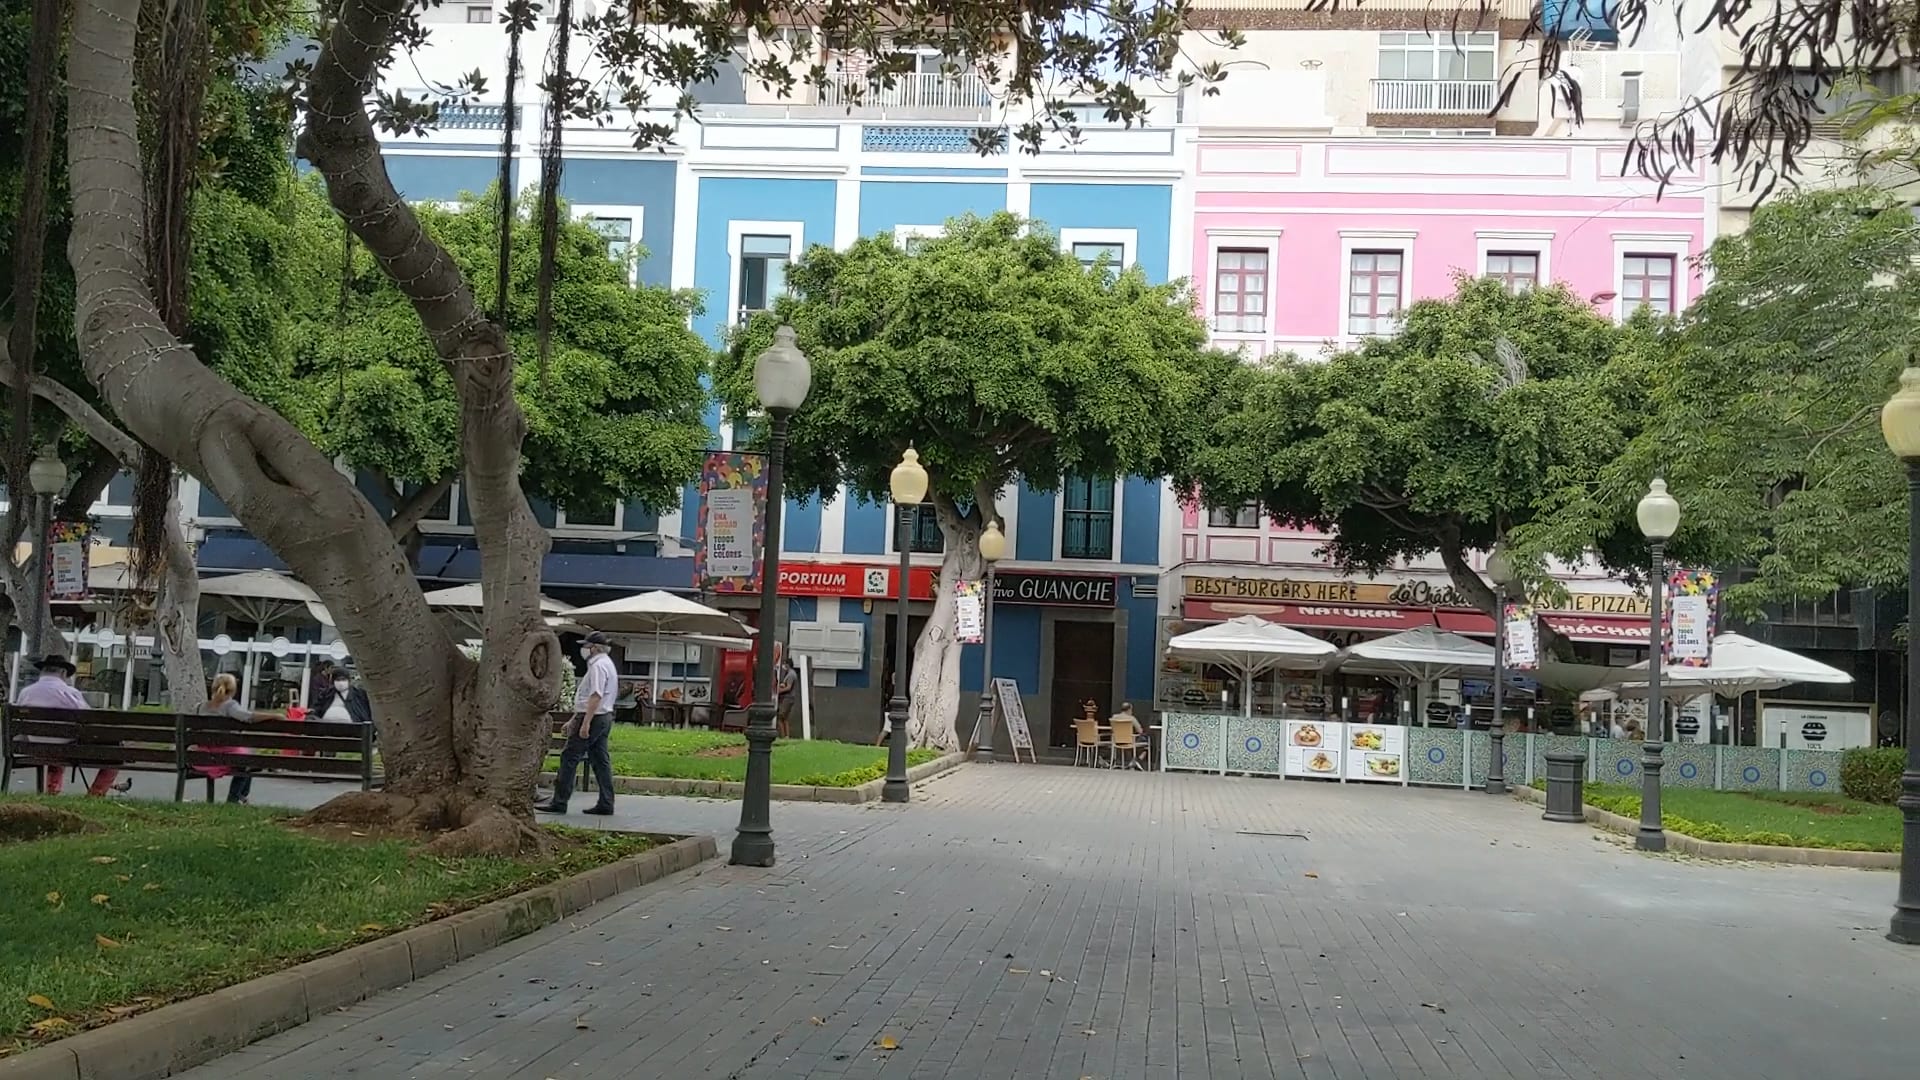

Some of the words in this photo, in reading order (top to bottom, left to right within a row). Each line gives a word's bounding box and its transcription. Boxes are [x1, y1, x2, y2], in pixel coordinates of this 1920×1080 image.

[713, 543, 726, 551] LOS
[713, 551, 743, 559] COLORES
[778, 571, 846, 586] PORTIUM
[1019, 578, 1113, 601] GUANCHE
[1194, 579, 1231, 595] BEST
[1236, 581, 1311, 599] BURGERS
[1317, 583, 1357, 601] HERE
[1591, 595, 1637, 613] PIZZA
[1298, 606, 1405, 619] NATURAL
